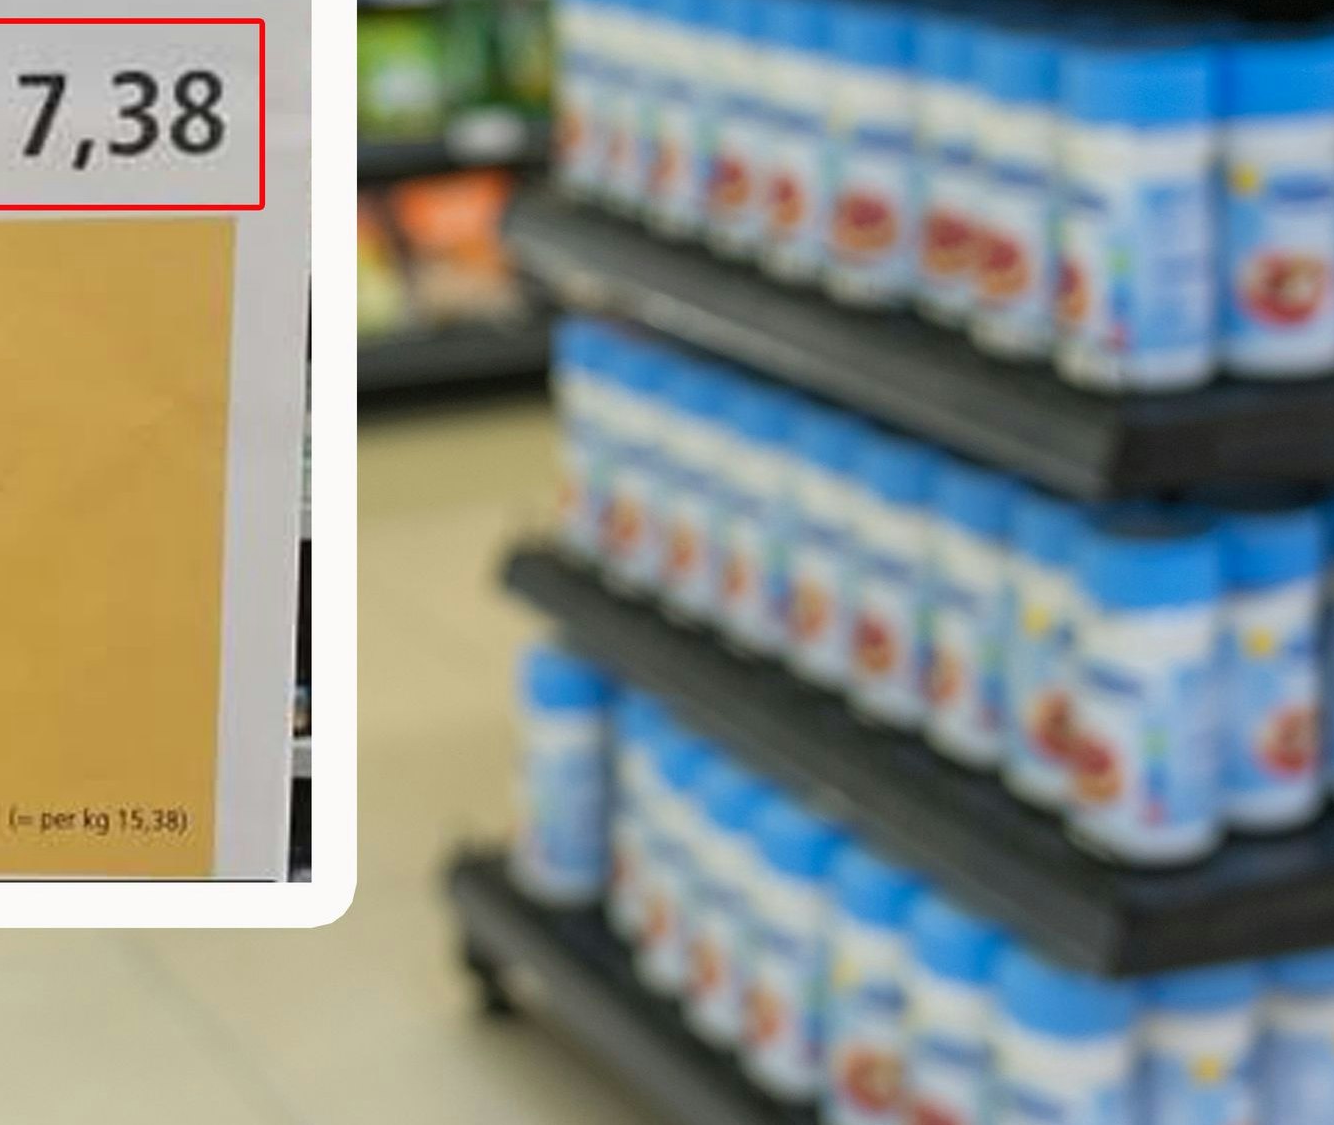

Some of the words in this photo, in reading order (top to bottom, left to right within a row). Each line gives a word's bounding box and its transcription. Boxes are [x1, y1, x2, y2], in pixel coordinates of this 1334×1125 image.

[16, 70, 226, 173] 7,38
[40, 811, 76, 833] per
[83, 807, 110, 836] kg
